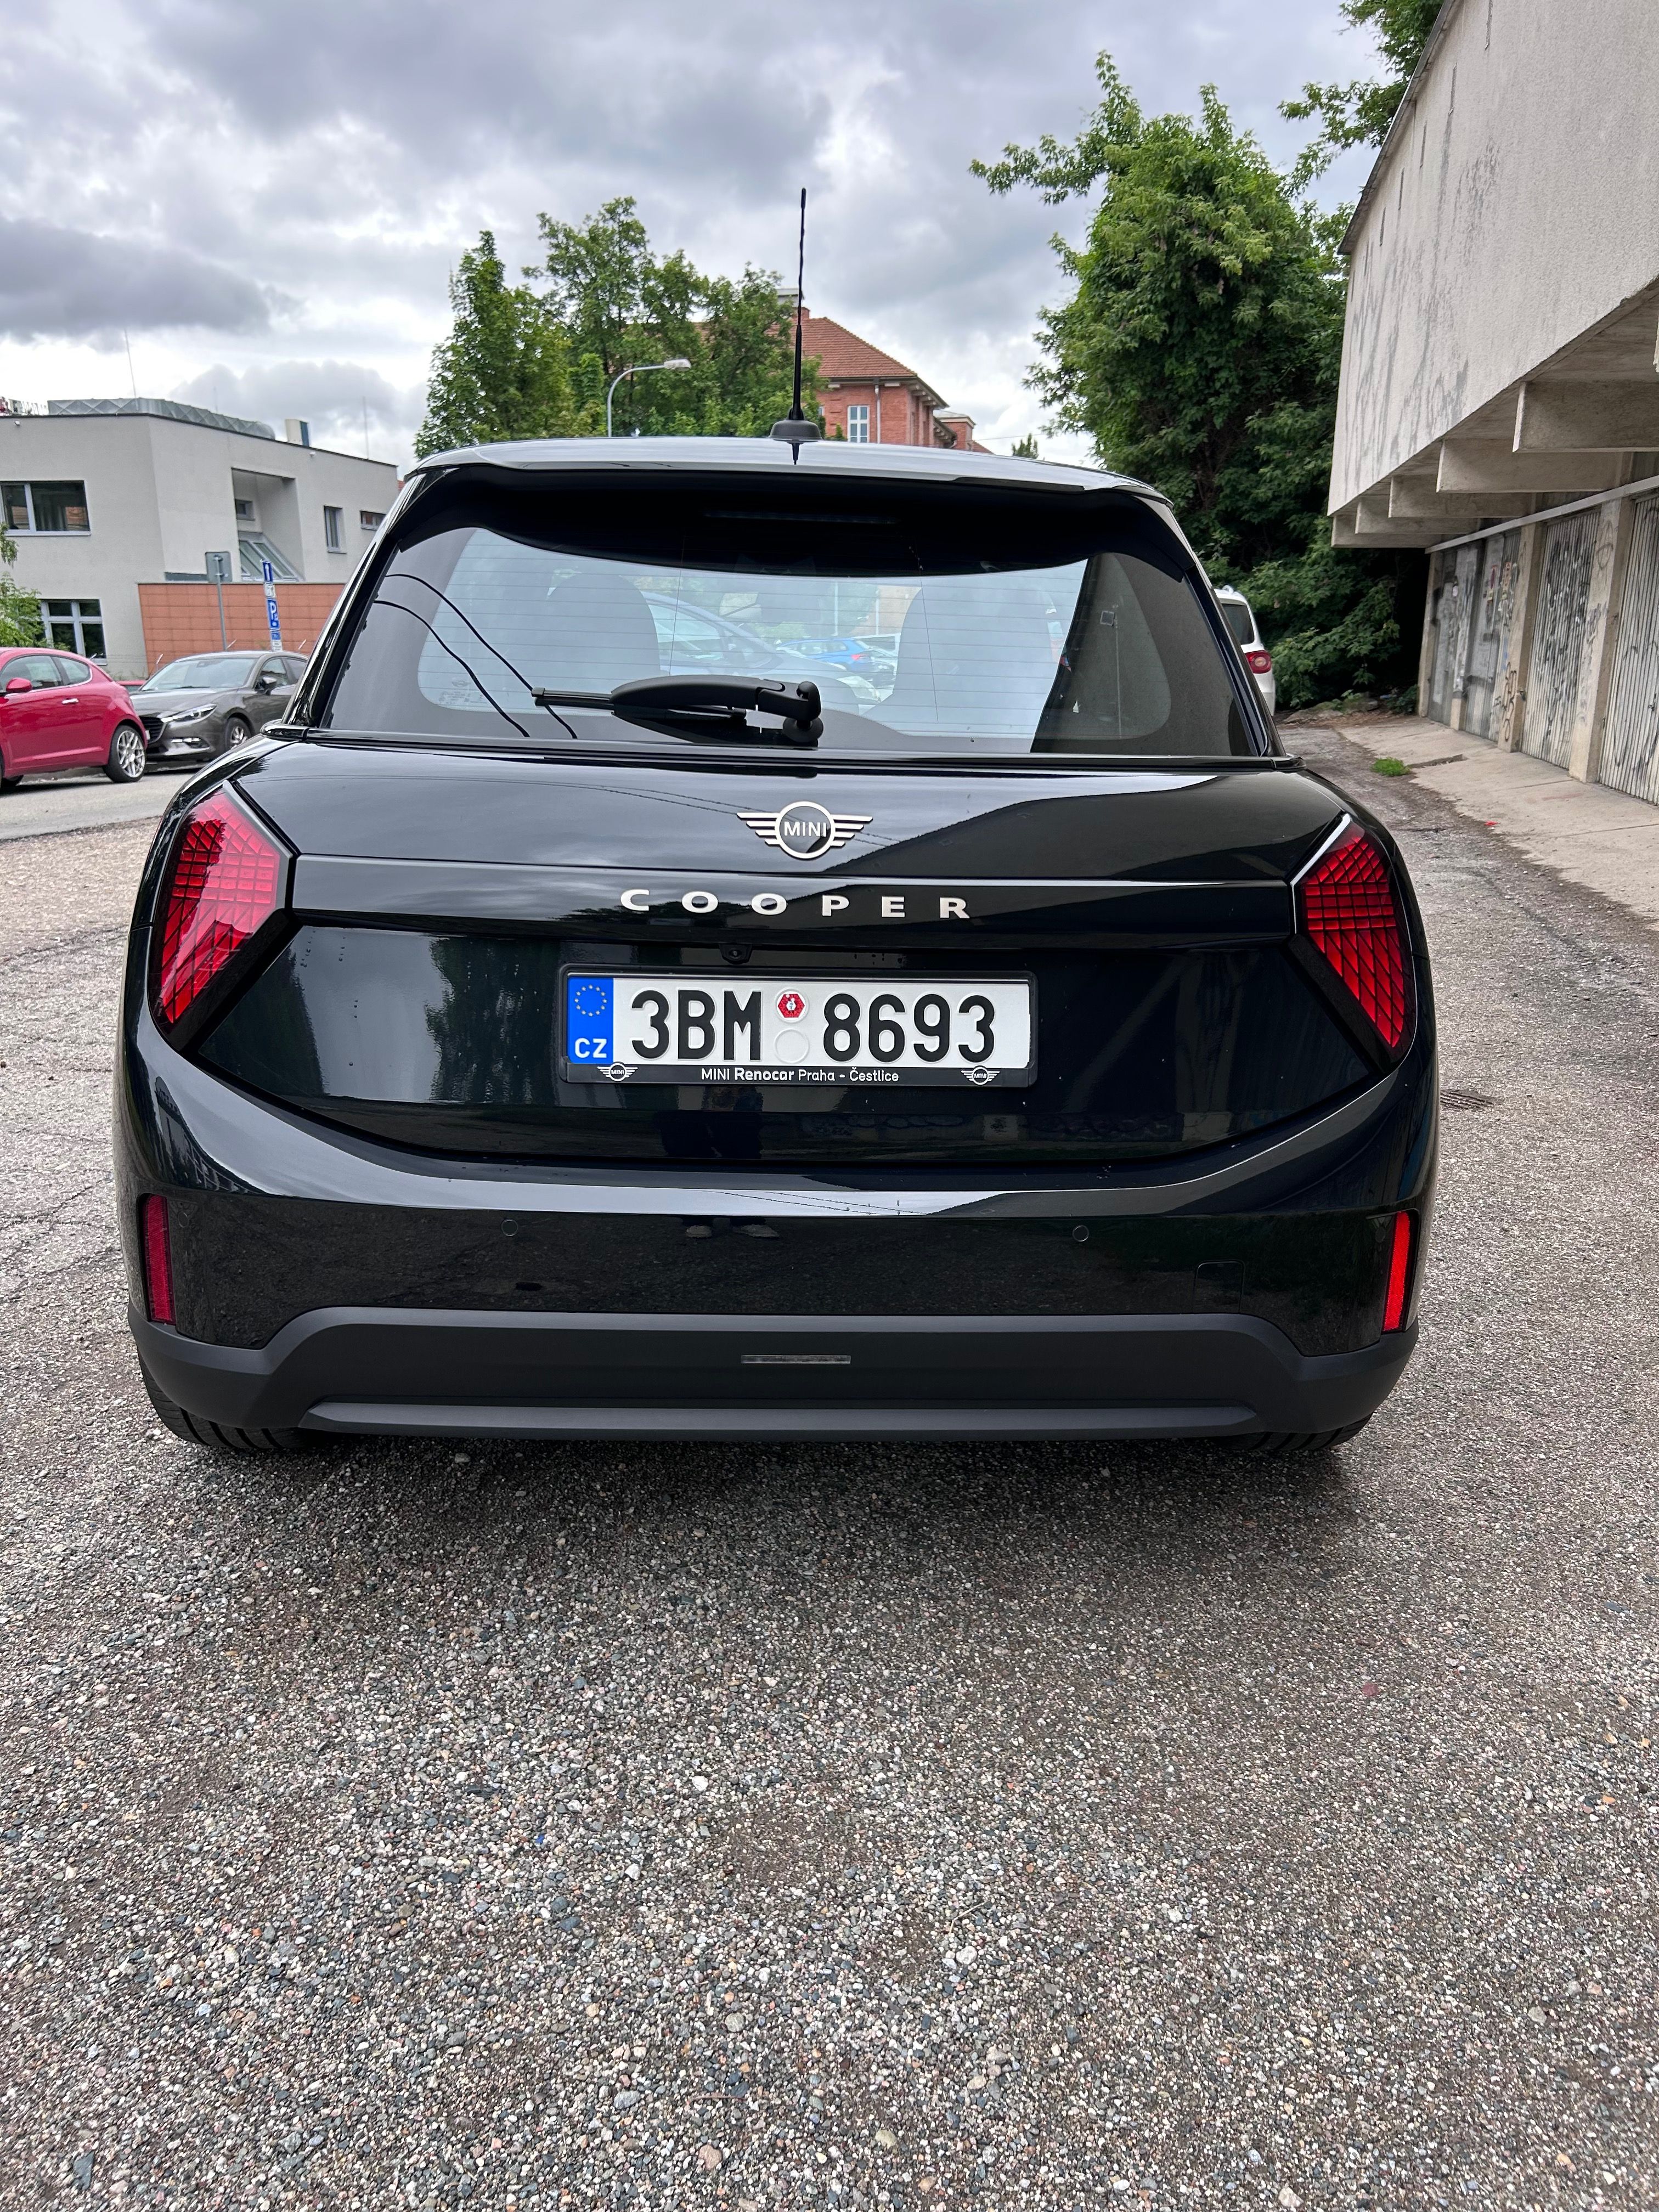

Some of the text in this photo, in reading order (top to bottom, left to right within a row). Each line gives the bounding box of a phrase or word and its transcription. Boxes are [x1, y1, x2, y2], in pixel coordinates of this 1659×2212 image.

[269, 602, 277, 620] P
[783, 821, 827, 837] MINI
[620, 888, 970, 919] COOPER
[631, 989, 996, 1064] 3BM 8693
[574, 1037, 607, 1059] CZ
[701, 1068, 730, 1081] MINI
[734, 1067, 794, 1081] Renocar
[798, 1069, 835, 1082] Praha
[849, 1066, 899, 1082] Čestlice
